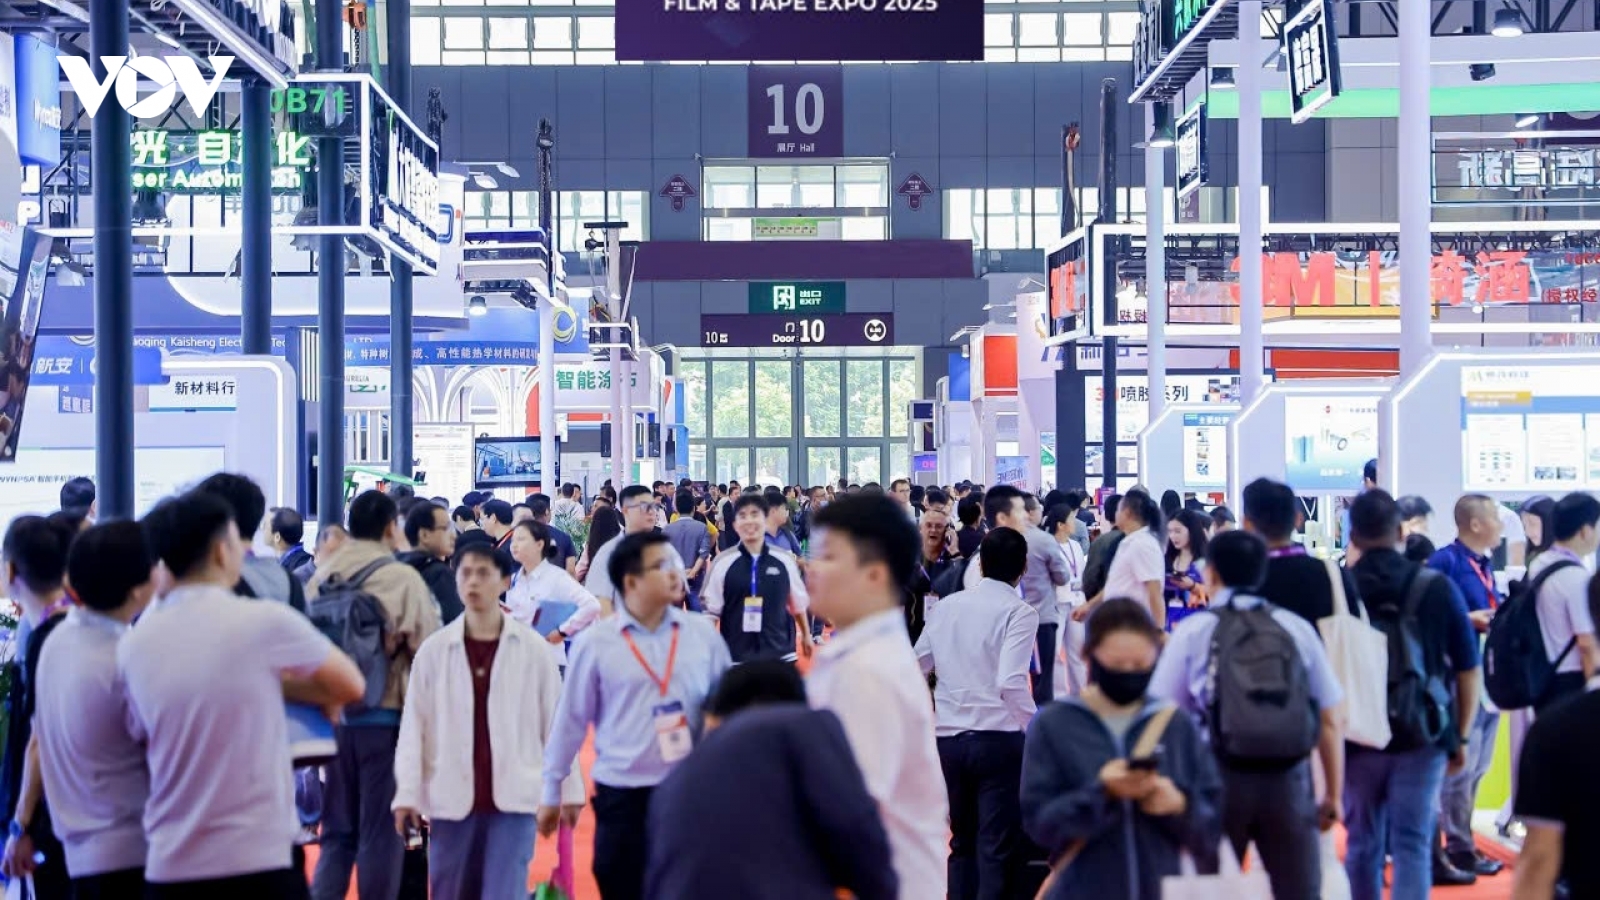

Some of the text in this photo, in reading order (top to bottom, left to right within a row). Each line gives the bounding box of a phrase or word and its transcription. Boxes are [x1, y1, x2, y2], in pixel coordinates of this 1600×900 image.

[664, 0, 938, 11] FILM & TAPE EXPO 2025
[766, 82, 825, 135] 10
[799, 142, 815, 153] Hall
[799, 290, 822, 298] 出口
[799, 298, 822, 306] EXIT
[772, 319, 826, 344] Door 10
[170, 337, 217, 349] Kaisheng
[35, 357, 72, 374] 新安
[556, 370, 638, 391] 智能涂
[174, 381, 236, 396] 新材料行
